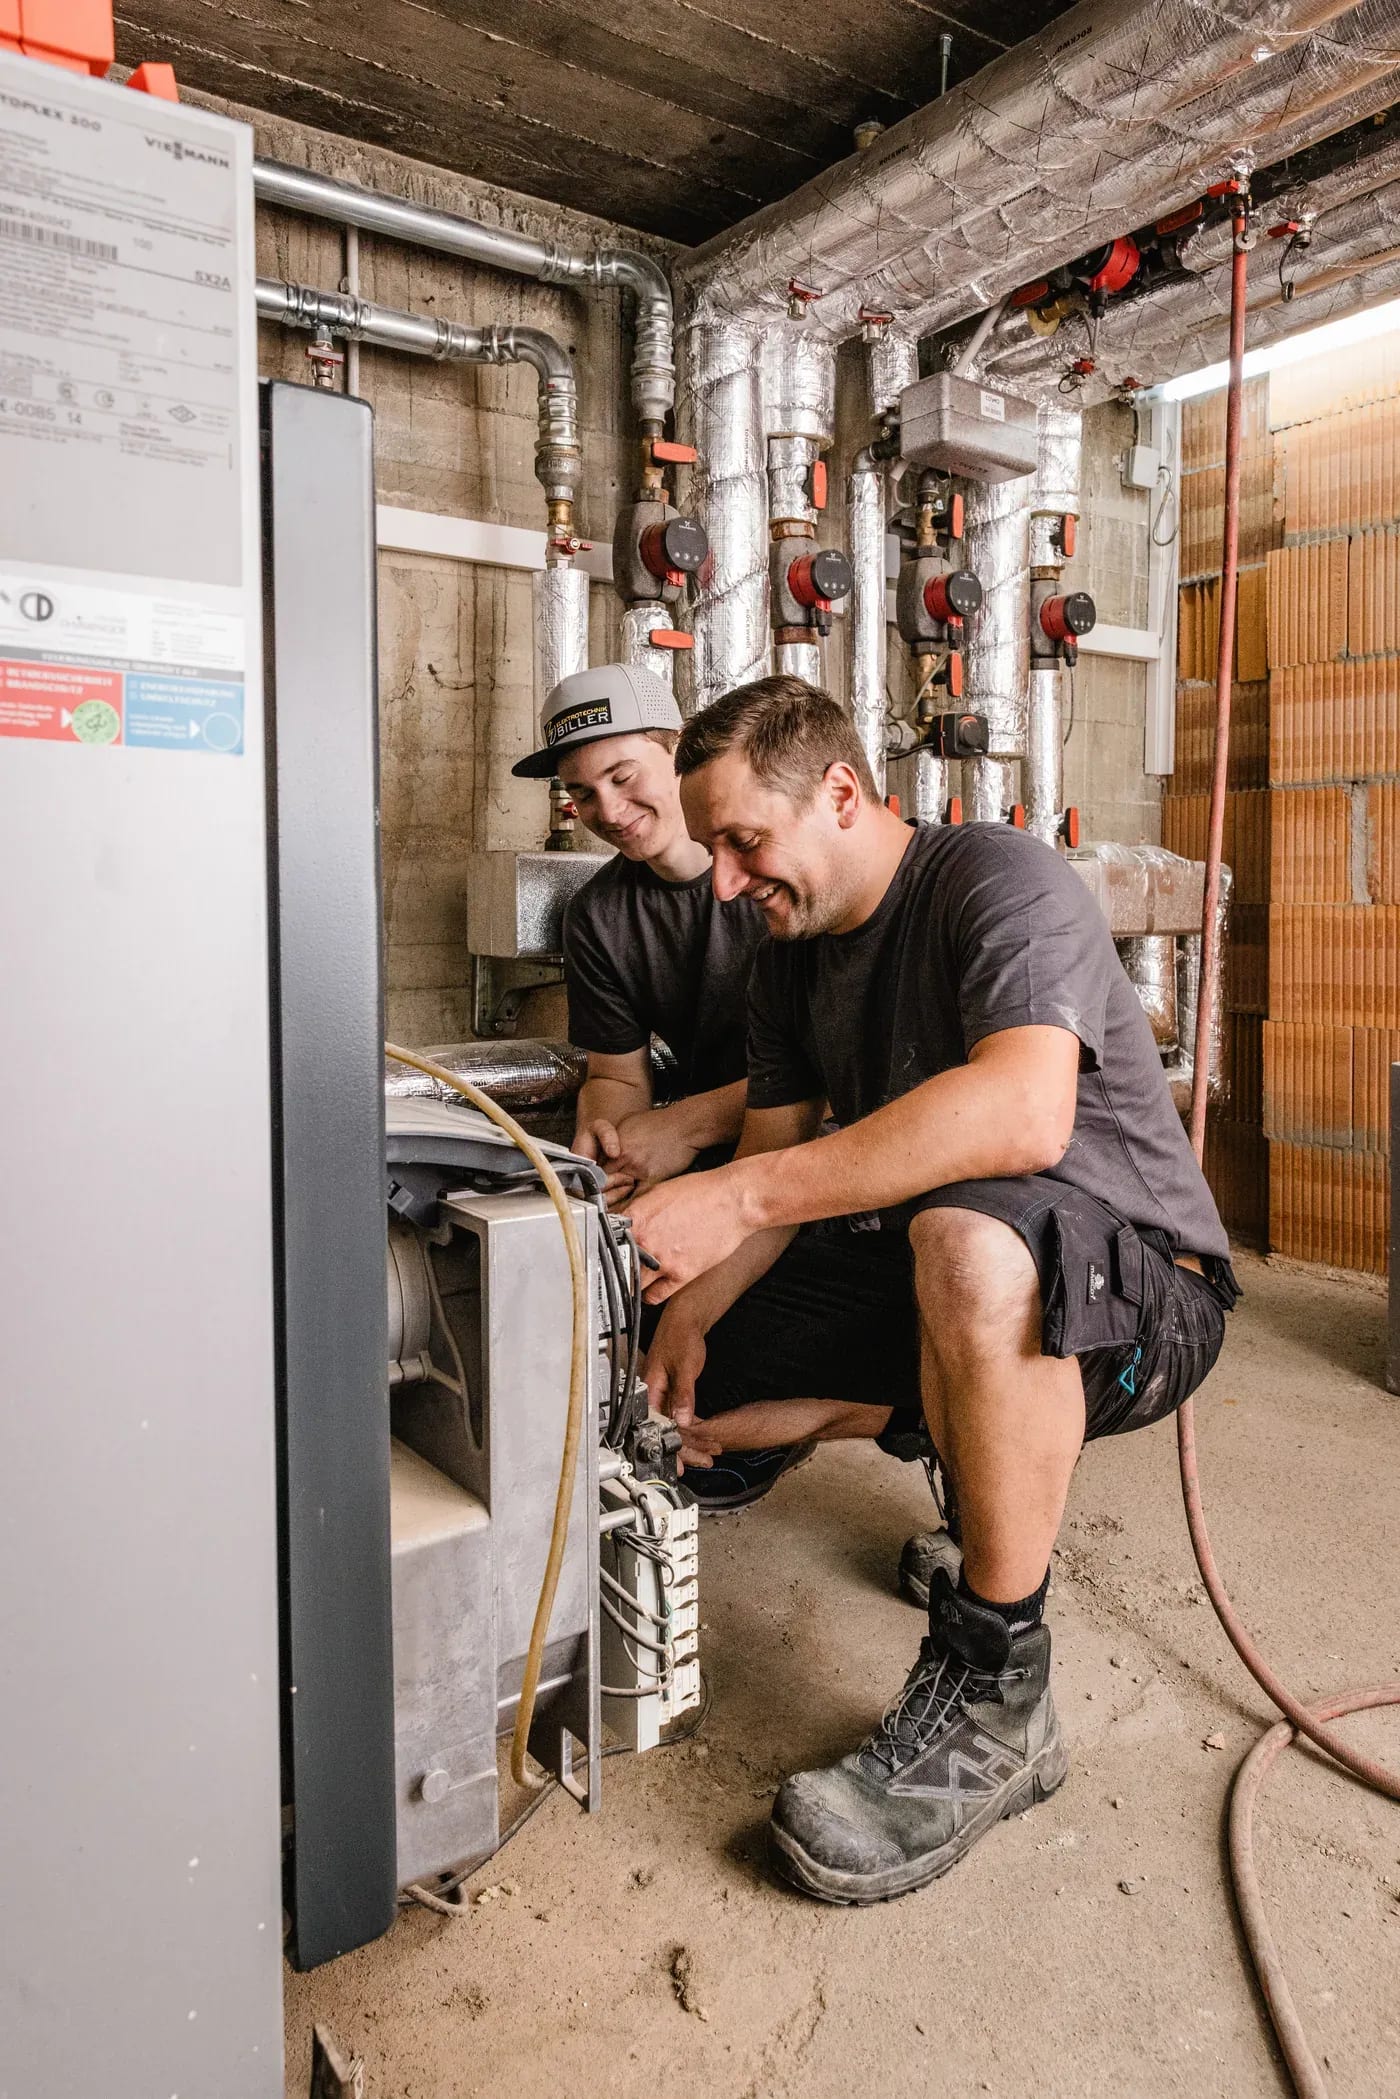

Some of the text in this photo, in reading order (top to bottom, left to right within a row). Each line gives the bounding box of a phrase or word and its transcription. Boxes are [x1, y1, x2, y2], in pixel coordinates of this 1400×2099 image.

[1050, 26, 1092, 59] ROCKWO
[556, 706, 608, 728] ELEKTROTECHNIK
[557, 712, 609, 737] BILLER
